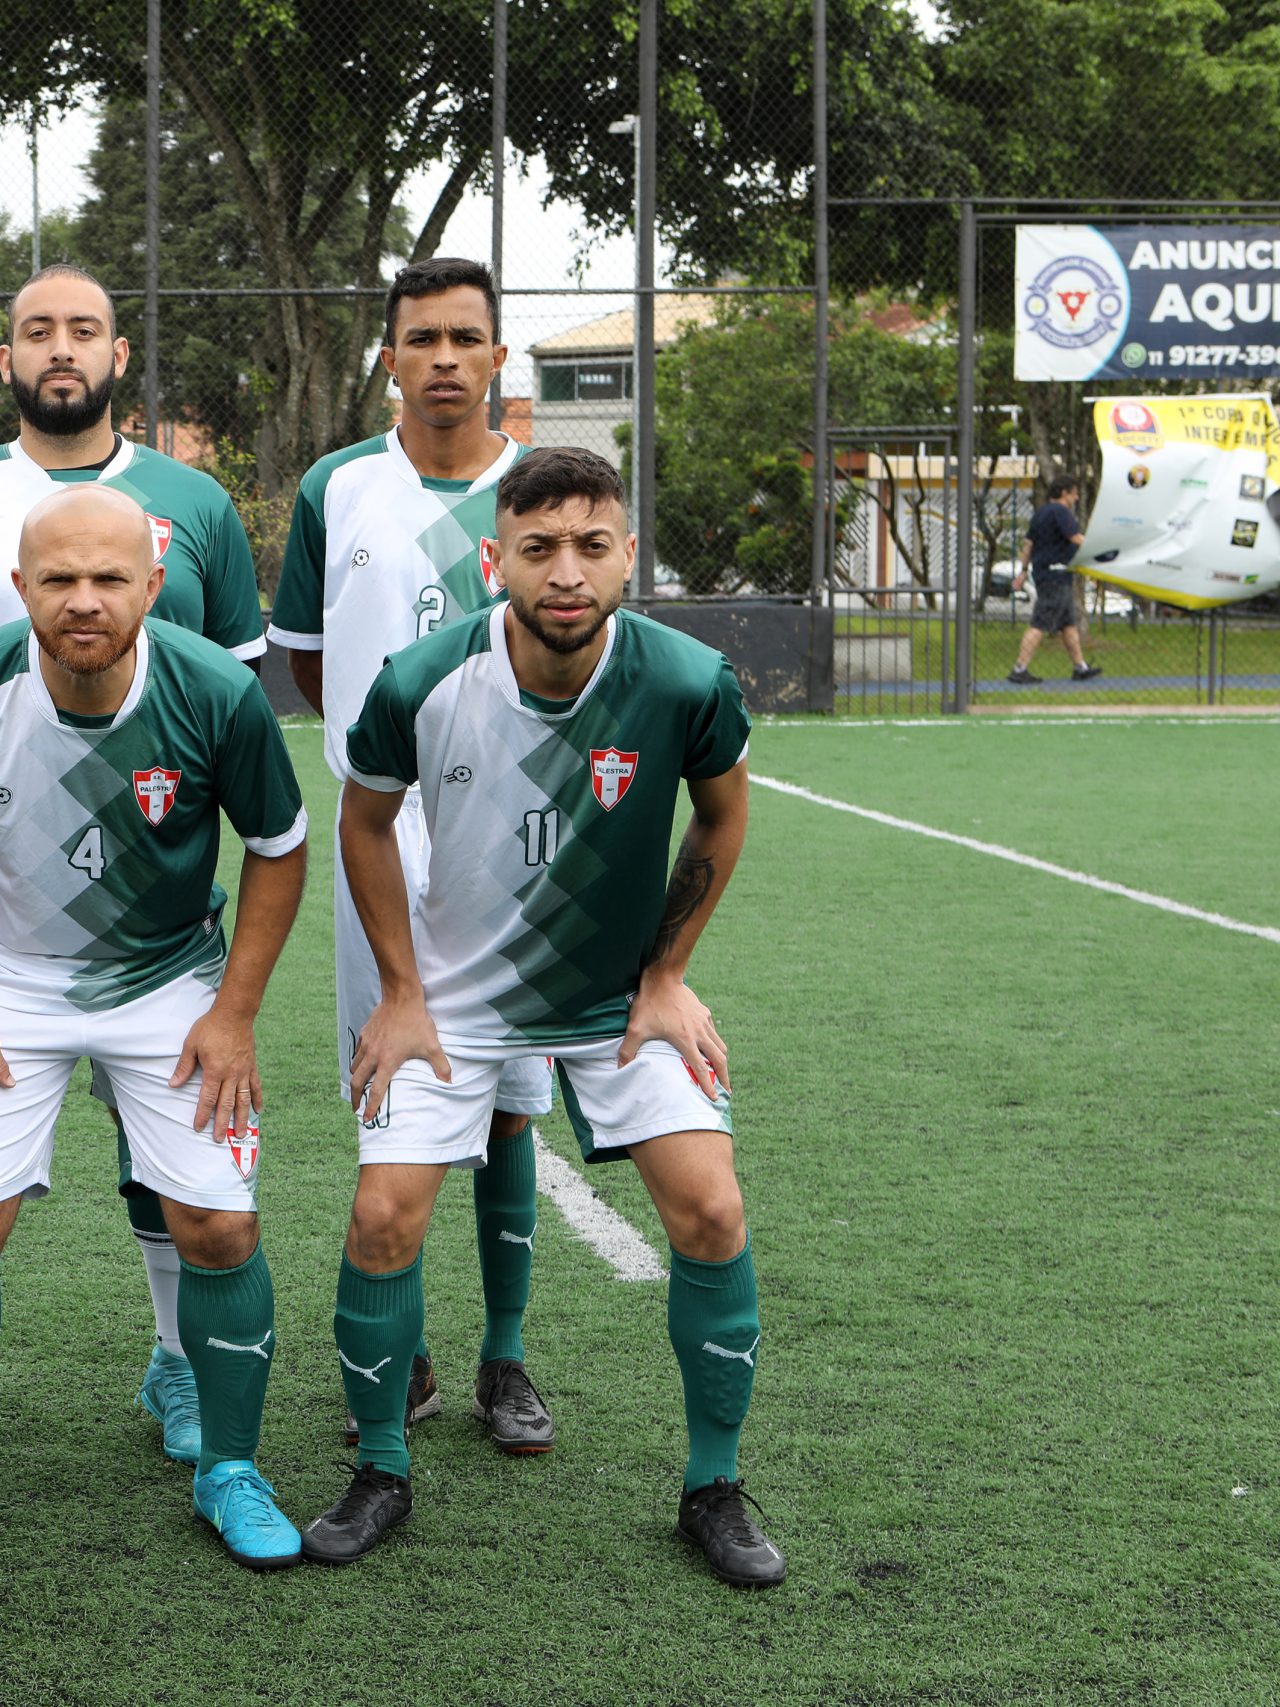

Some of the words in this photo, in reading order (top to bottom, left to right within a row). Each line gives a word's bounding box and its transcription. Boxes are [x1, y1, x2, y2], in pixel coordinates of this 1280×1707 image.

[1148, 351, 1164, 366] 11
[1169, 344, 1280, 366] 91277-39
[417, 585, 446, 640] 2
[68, 825, 106, 881] 4
[524, 808, 559, 866] 11
